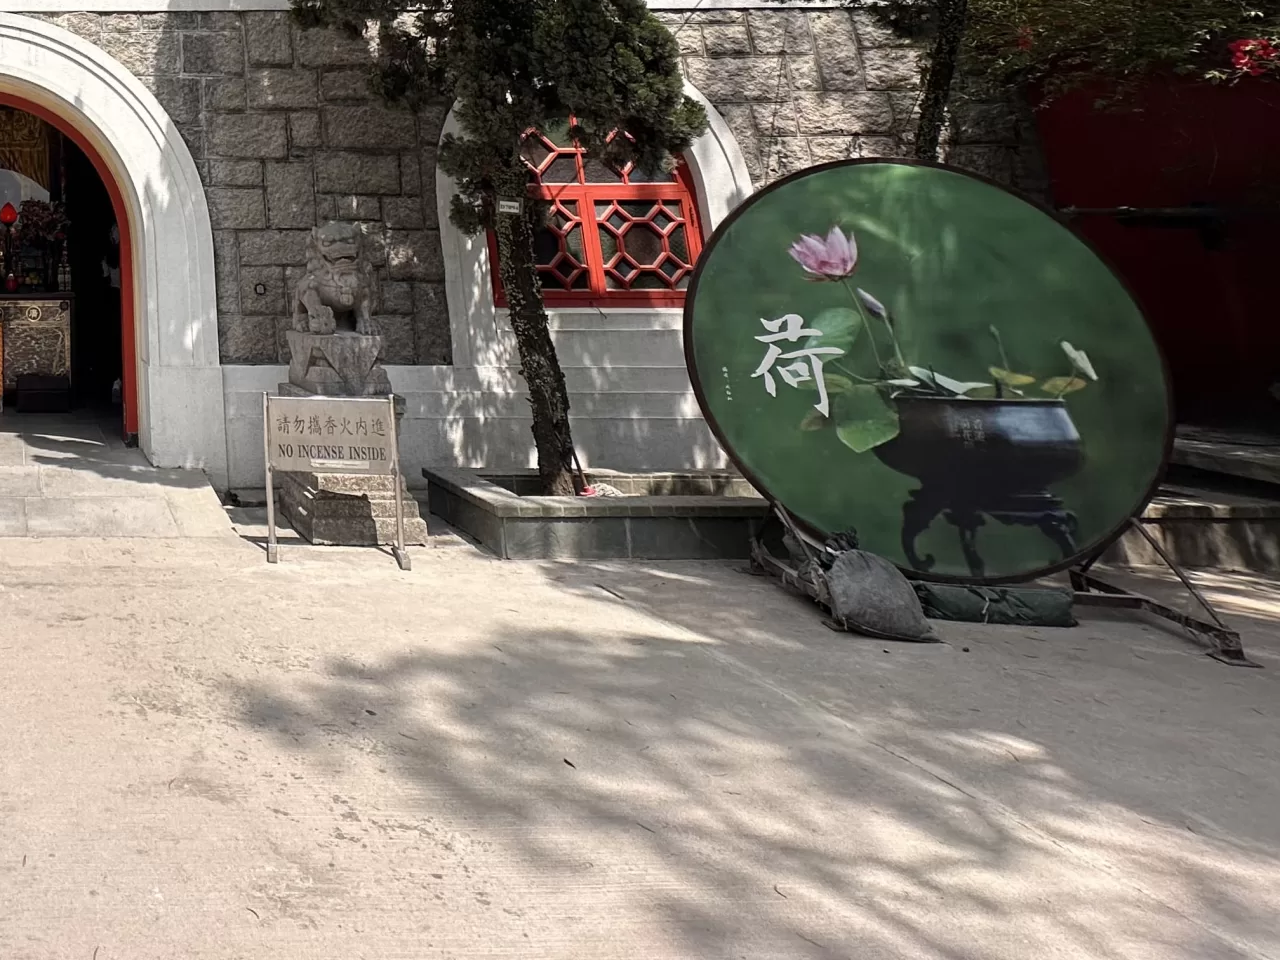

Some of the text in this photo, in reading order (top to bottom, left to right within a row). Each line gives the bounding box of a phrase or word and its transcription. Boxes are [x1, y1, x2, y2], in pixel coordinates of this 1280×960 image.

[750, 313, 845, 418] 荷
[276, 414, 386, 437] 請勿攜香火內進
[278, 444, 386, 461] NO INCENSE INSIDE
